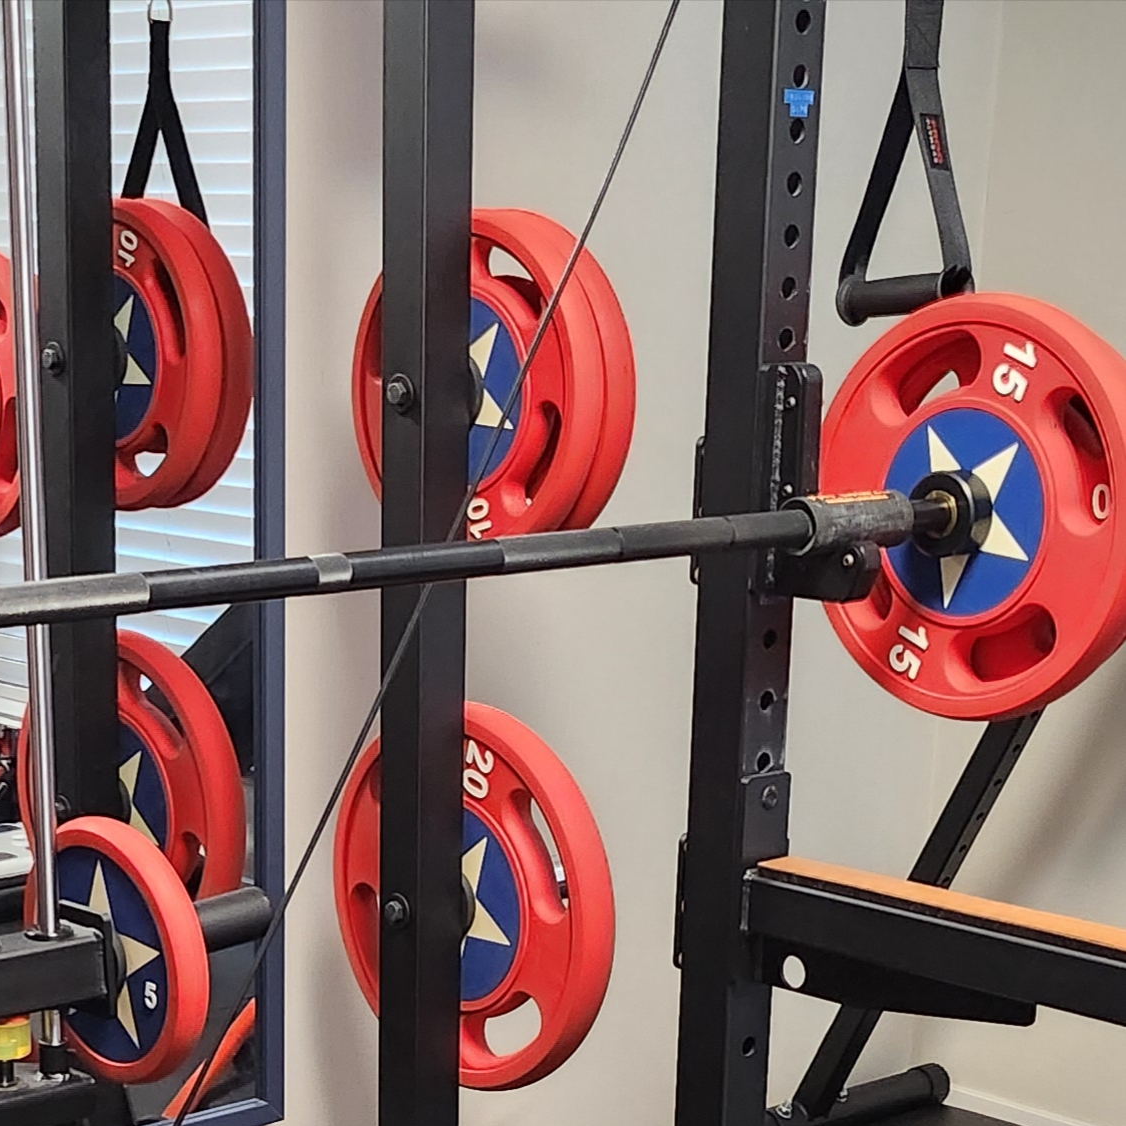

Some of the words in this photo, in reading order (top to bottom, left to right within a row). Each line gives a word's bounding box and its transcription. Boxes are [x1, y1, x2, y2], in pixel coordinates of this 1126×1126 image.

[992, 341, 1038, 402] 15
[466, 497, 492, 539] 10
[888, 625, 930, 680] 15
[463, 739, 494, 799] 20
[144, 980, 157, 1009] 5
